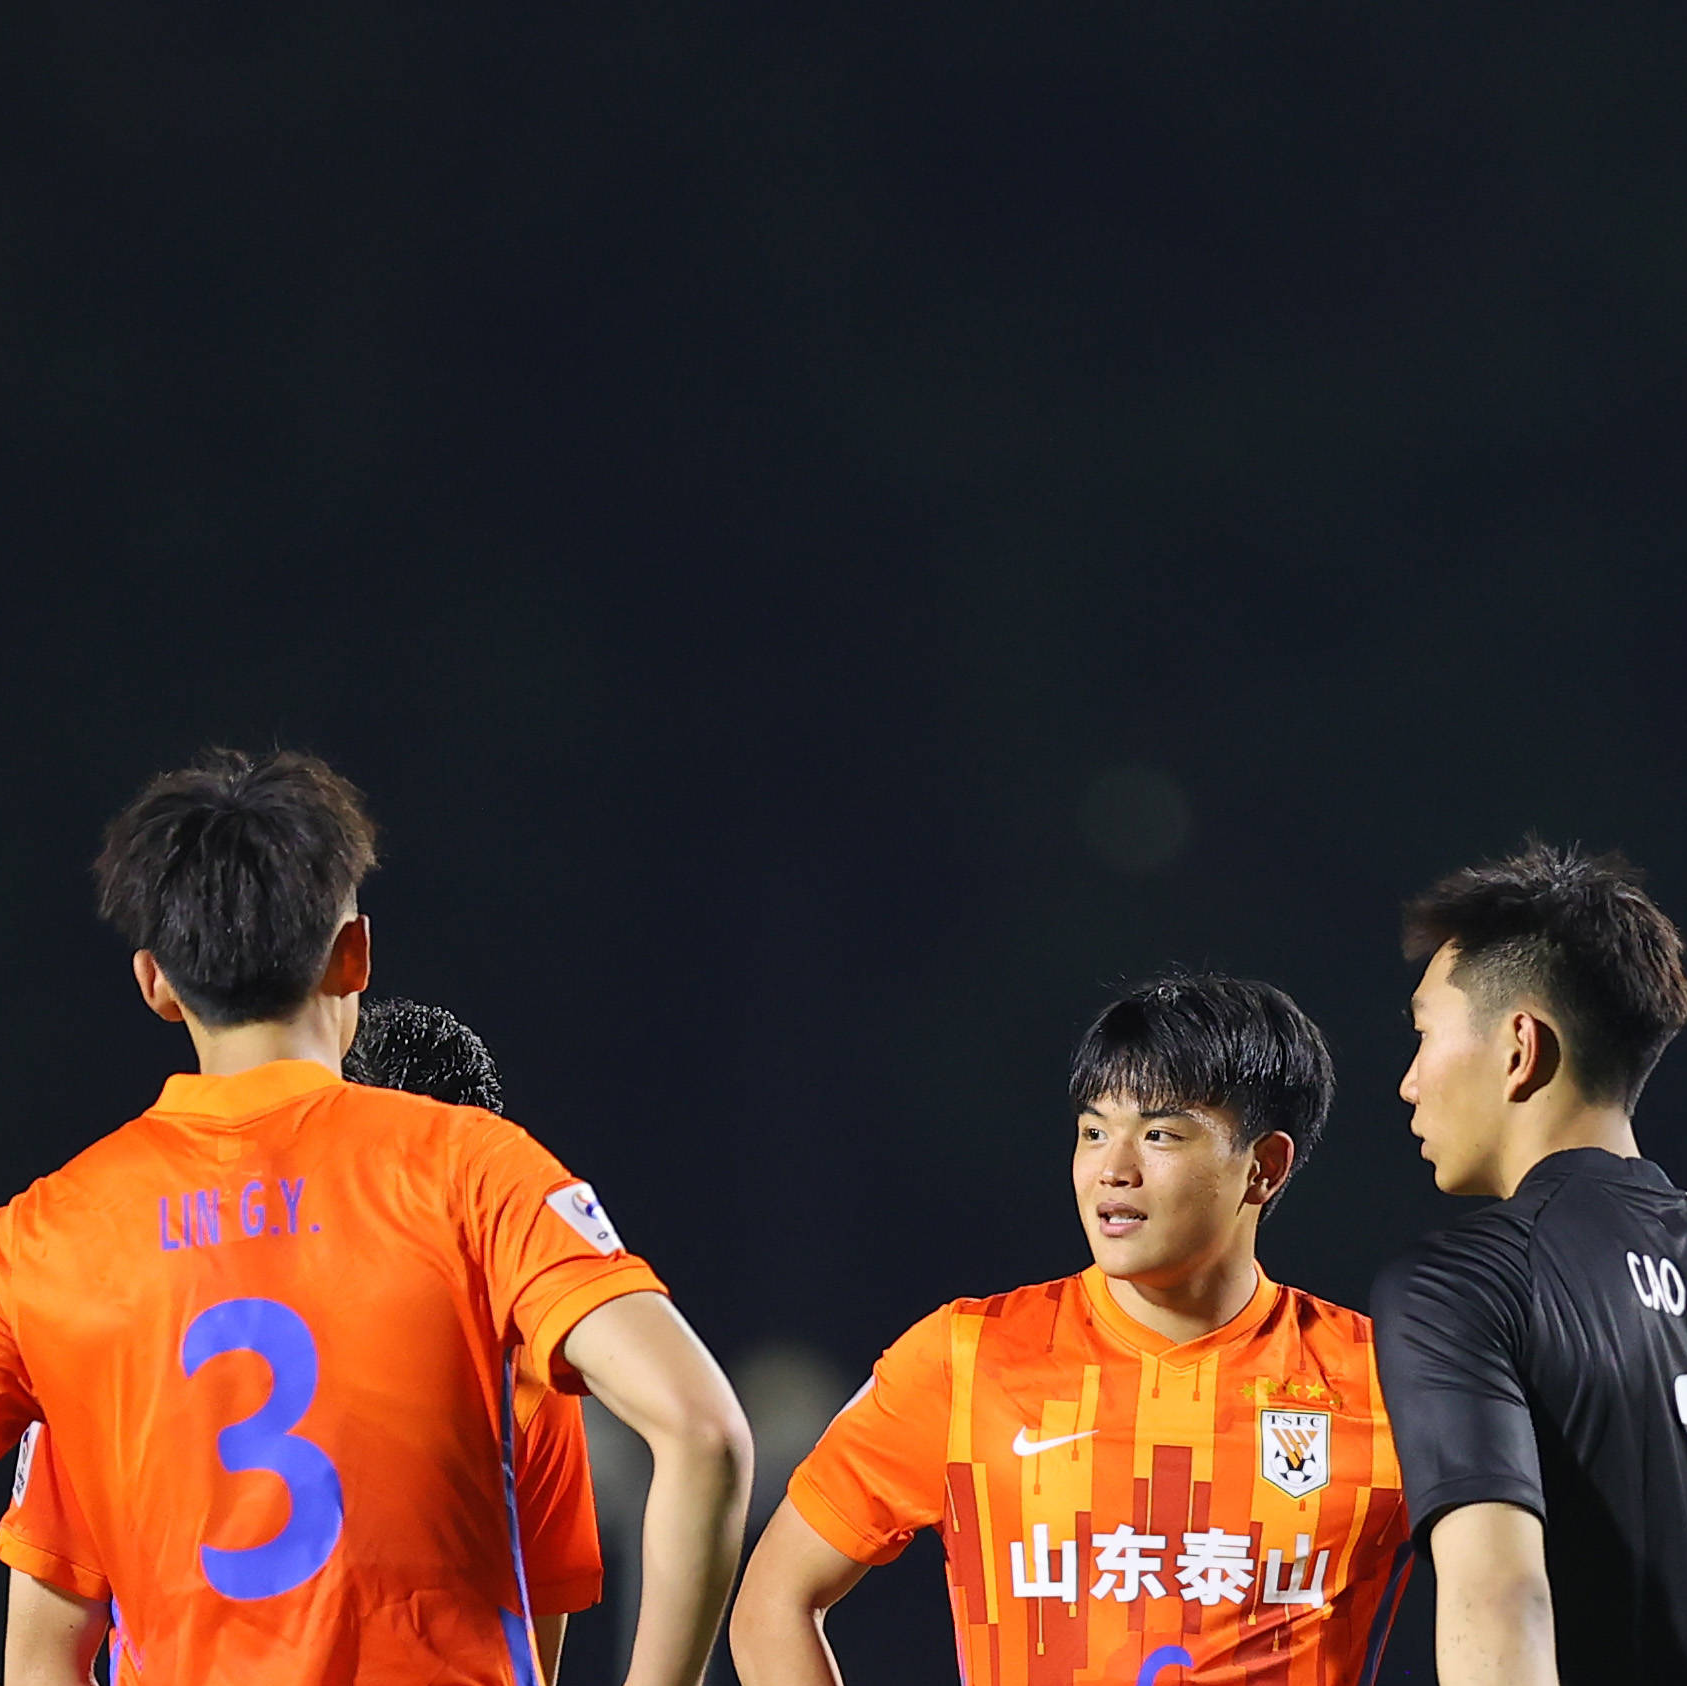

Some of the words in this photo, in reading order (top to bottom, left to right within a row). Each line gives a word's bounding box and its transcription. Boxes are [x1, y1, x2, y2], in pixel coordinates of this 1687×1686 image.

[159, 1188, 220, 1250] LIN
[240, 1177, 320, 1238] G.Y.
[1626, 1250, 1686, 1317] CAO
[181, 1298, 344, 1600] 3
[1267, 1413, 1321, 1428] TSFC
[1010, 1523, 1330, 1608] 山东泰山
